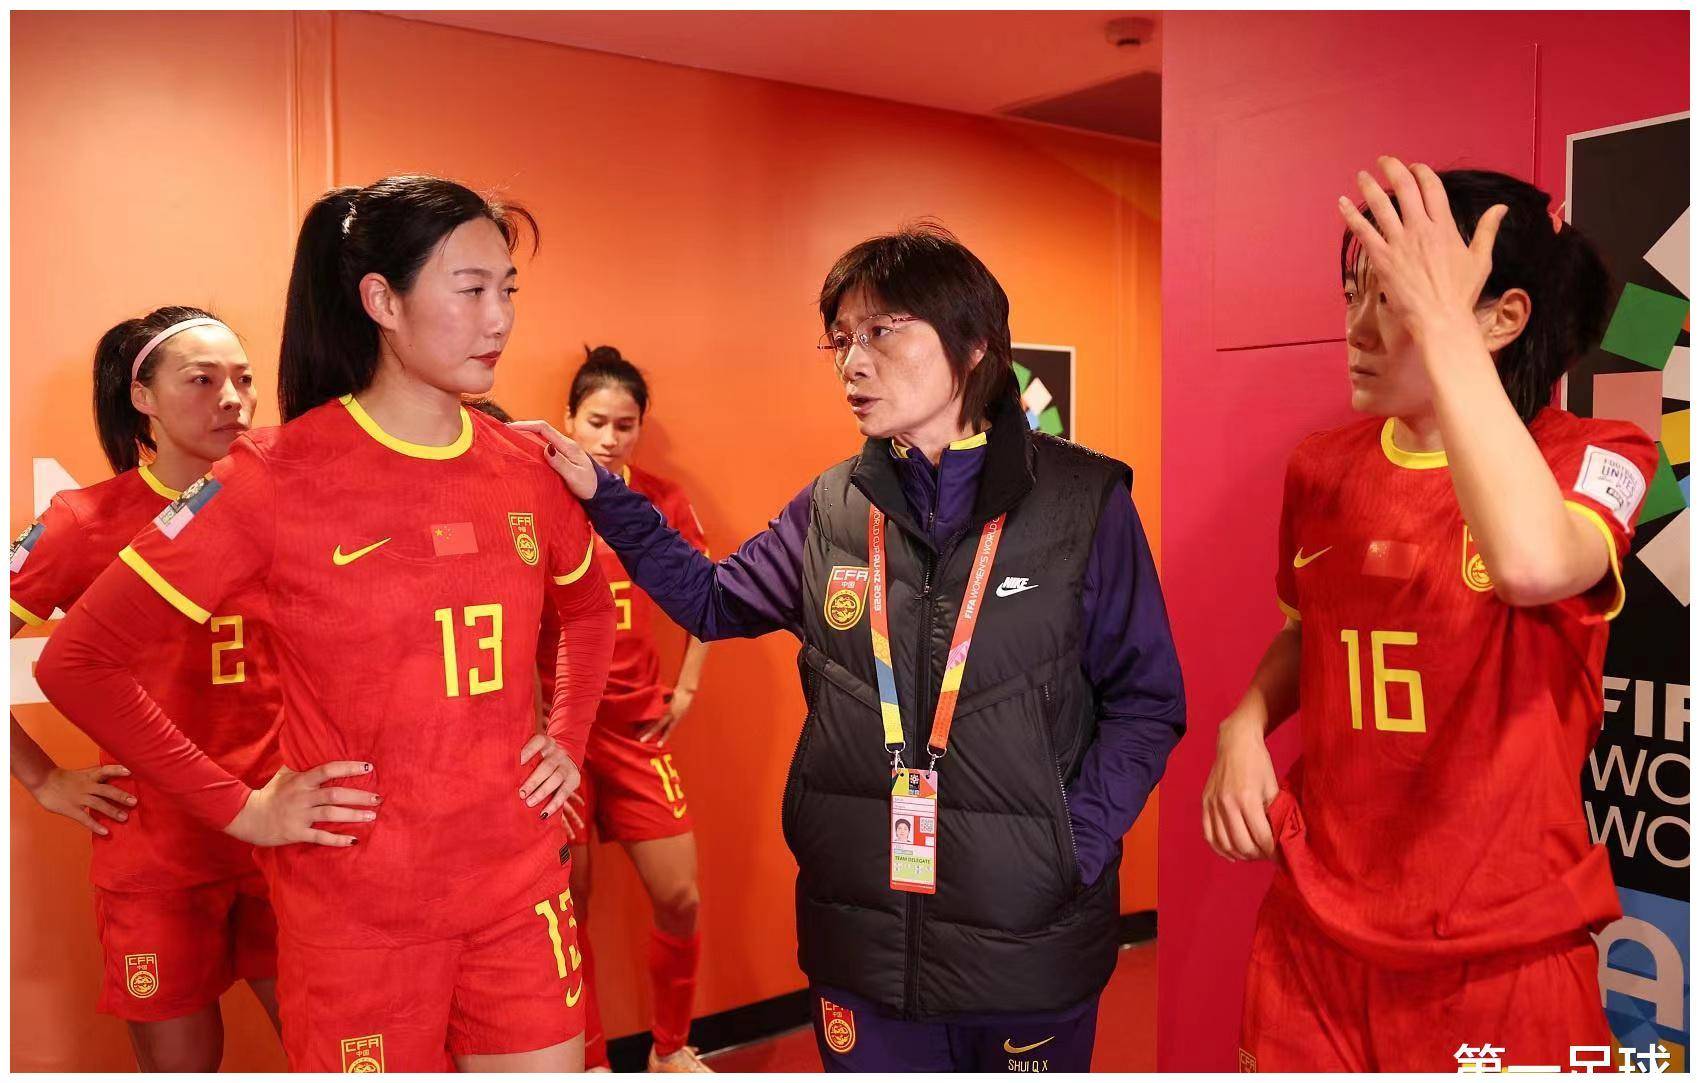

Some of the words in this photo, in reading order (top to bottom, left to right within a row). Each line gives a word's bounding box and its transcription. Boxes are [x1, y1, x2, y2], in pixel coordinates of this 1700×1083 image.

[510, 515, 531, 526] CFA
[833, 569, 868, 581] CFA
[964, 599, 977, 620] FIFA
[971, 556, 989, 599] WOMEN'S
[984, 523, 998, 555] WORLD
[1002, 576, 1030, 589] NIKE
[210, 614, 246, 685] 2
[434, 603, 503, 697] 13
[1340, 629, 1427, 733] 16
[128, 956, 155, 966] CFA
[345, 1038, 379, 1053] CFA
[1008, 1059, 1030, 1073] SHUI
[1032, 1060, 1040, 1073] Q
[1041, 1059, 1049, 1072] X
